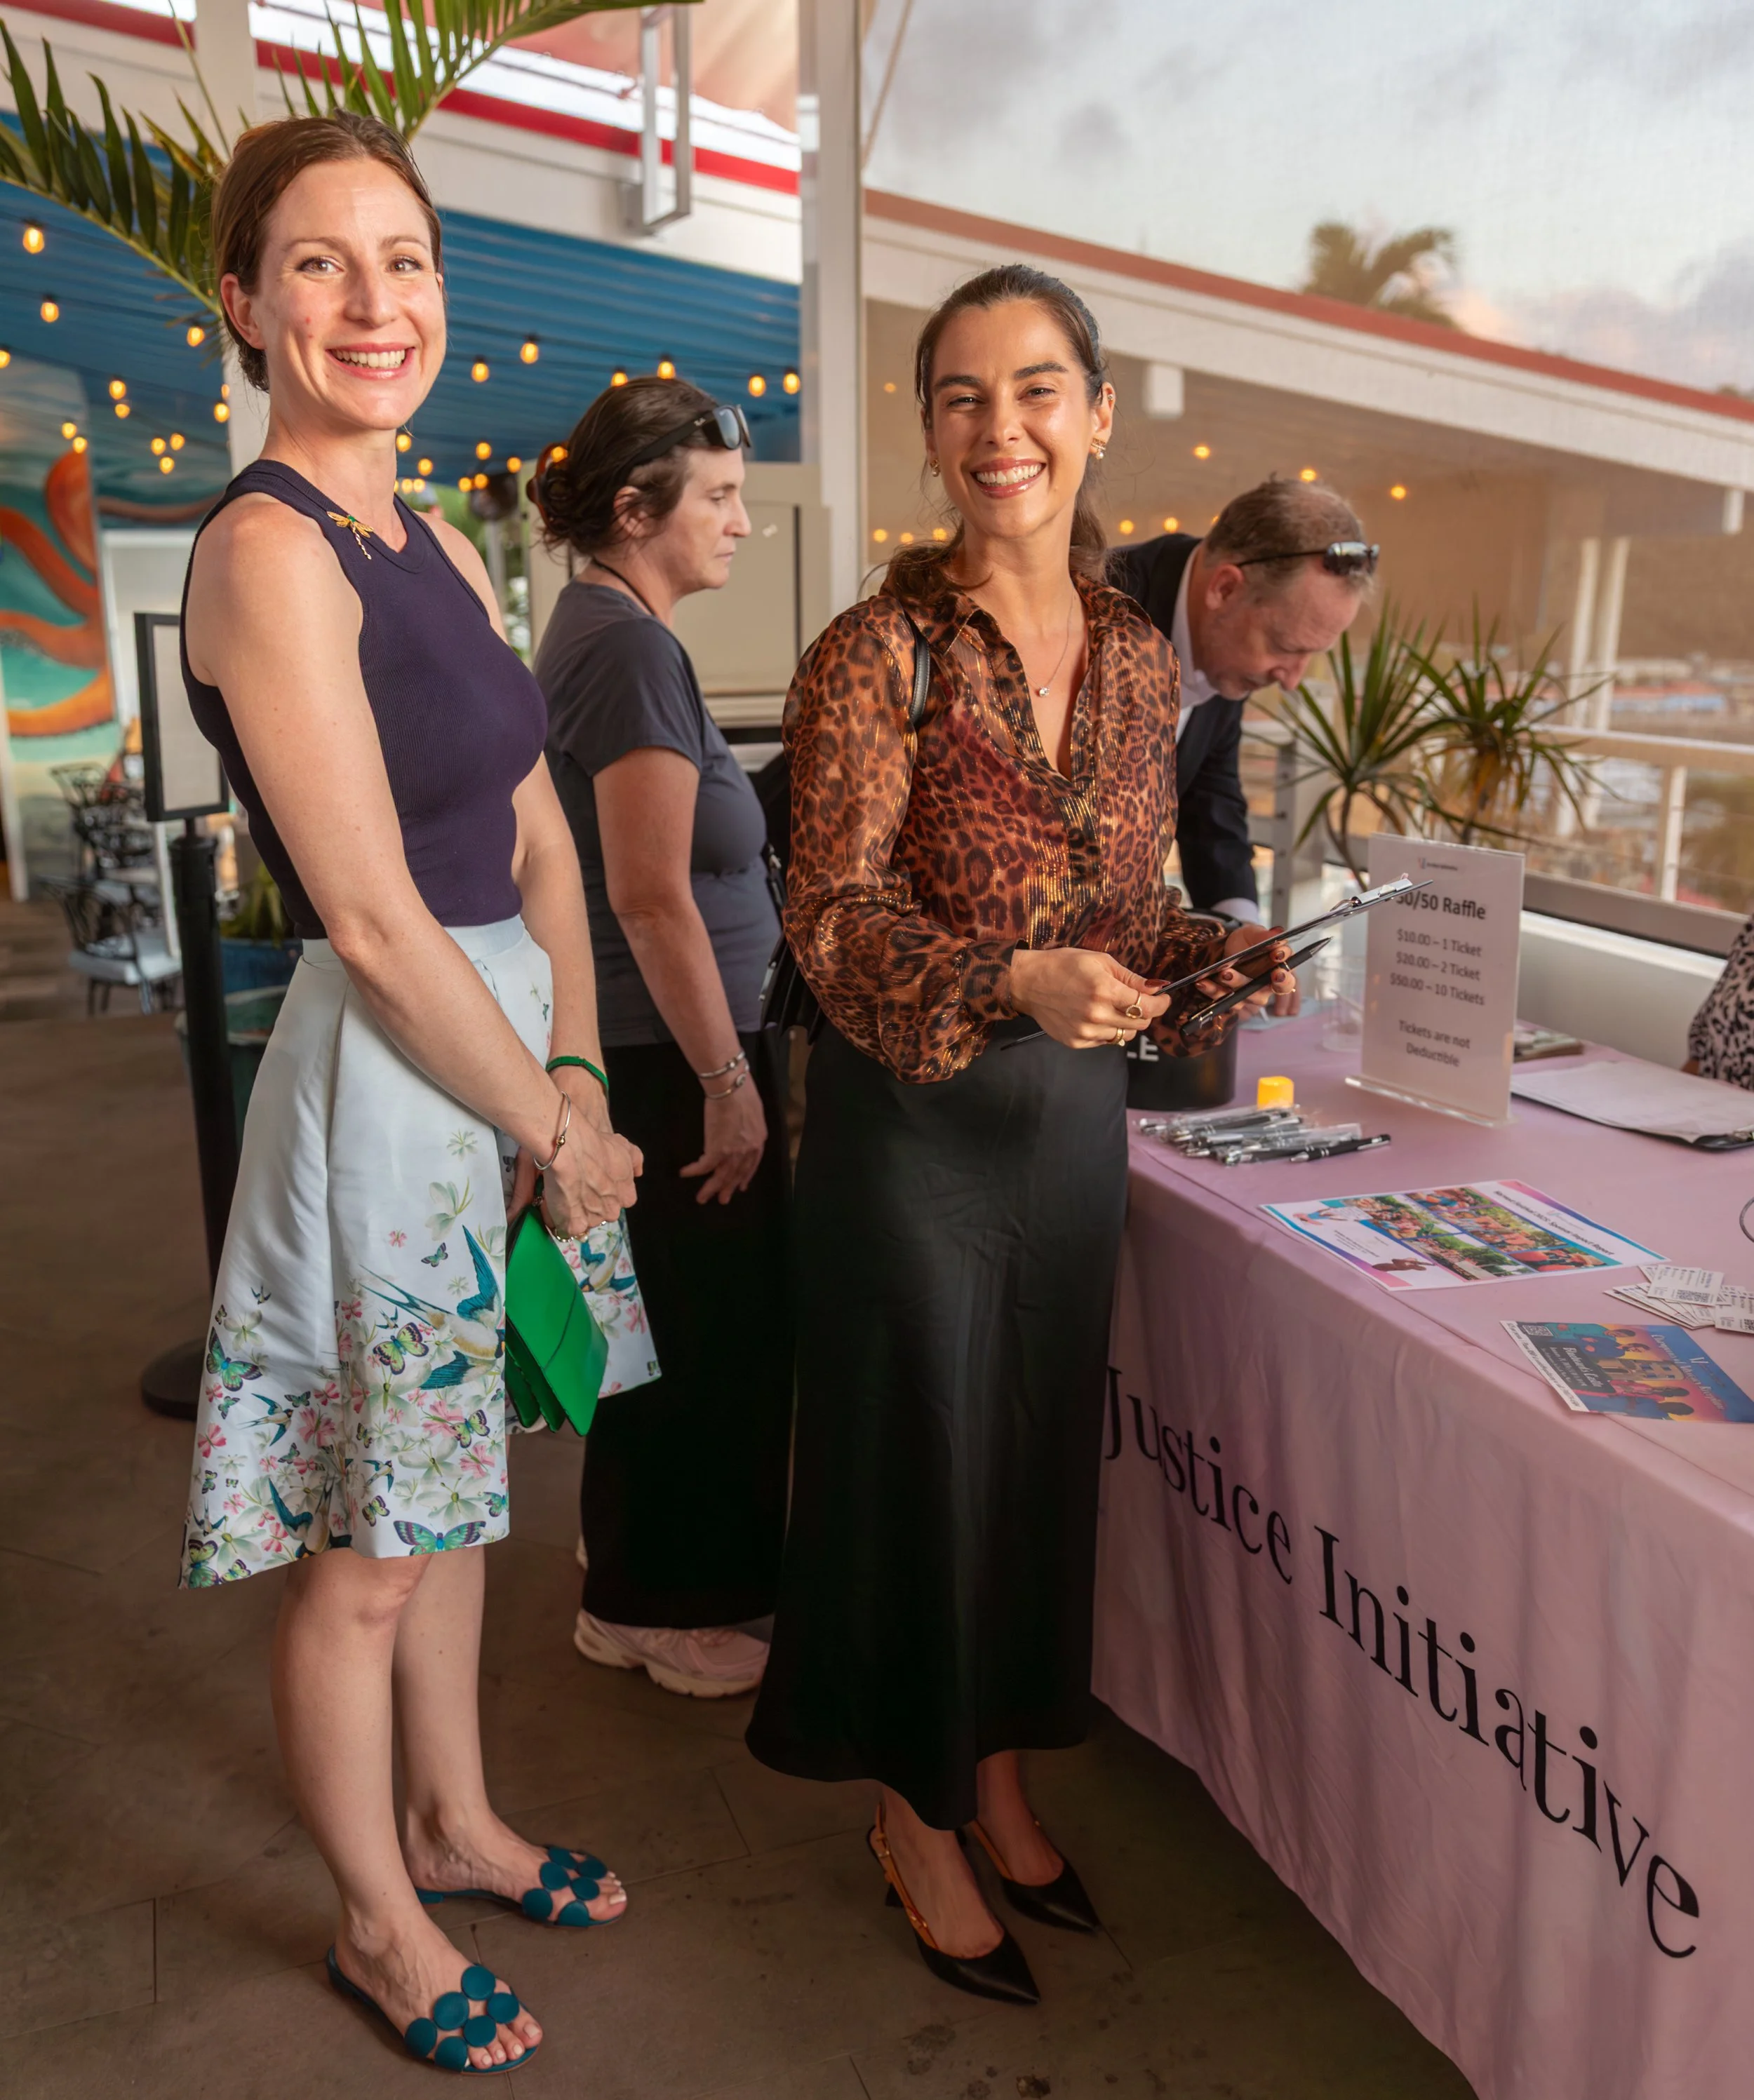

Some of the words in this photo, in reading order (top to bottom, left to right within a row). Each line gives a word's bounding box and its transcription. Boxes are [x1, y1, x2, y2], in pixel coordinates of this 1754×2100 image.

[1443, 896, 1485, 920] Raffle
[1397, 928, 1431, 946] $10.00
[1442, 938, 1447, 950] 1
[1451, 939, 1482, 957] Ticket
[1396, 951, 1430, 969] $20.00
[1440, 961, 1447, 974] 2
[1450, 963, 1480, 981] Ticket
[1435, 983, 1447, 996] 10
[1450, 986, 1485, 1006] Tickets
[1399, 1019, 1431, 1039] Tickets
[1434, 1031, 1450, 1044] are
[1452, 1037, 1470, 1049] not
[1406, 1042, 1460, 1067] Deductible
[1105, 1365, 1292, 1585] Justice
[1313, 1525, 1700, 1958] Initiative
